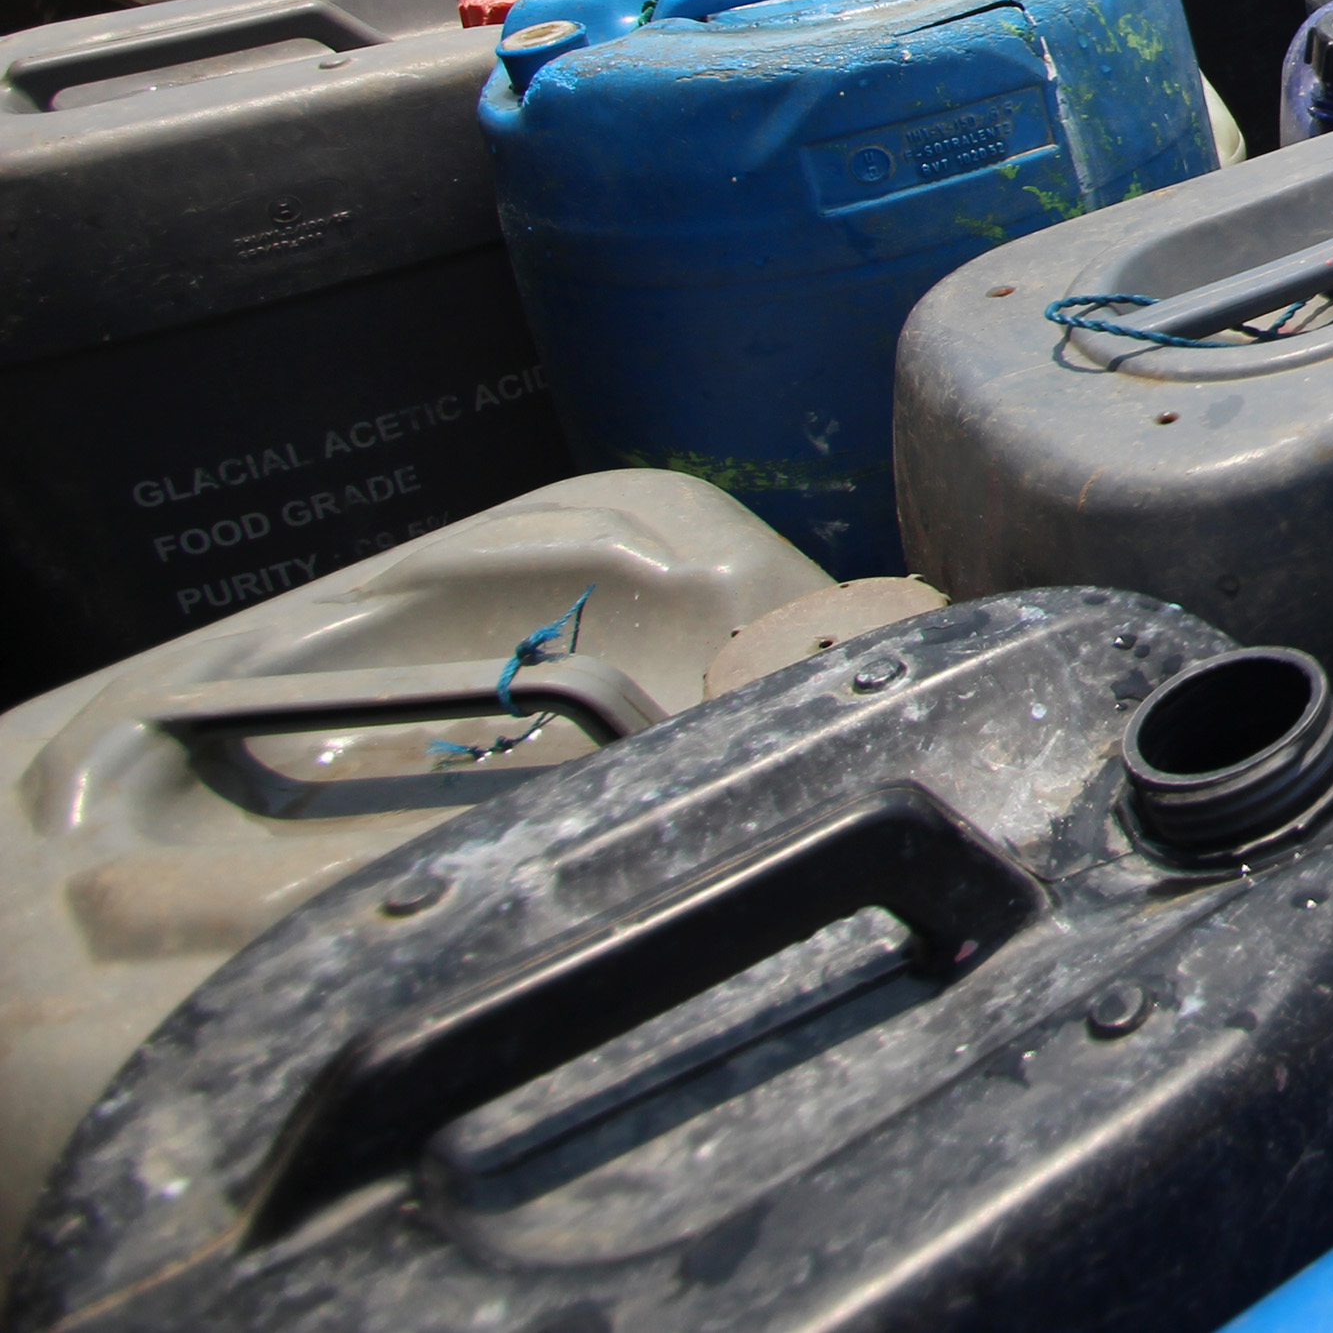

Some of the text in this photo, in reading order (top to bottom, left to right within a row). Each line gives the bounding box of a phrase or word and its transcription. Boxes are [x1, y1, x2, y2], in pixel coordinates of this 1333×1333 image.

[132, 442, 314, 509] GLACIAL
[324, 394, 462, 459] ACETIC
[153, 465, 422, 563] FOOD GRADE
[176, 553, 318, 614] PURITY
